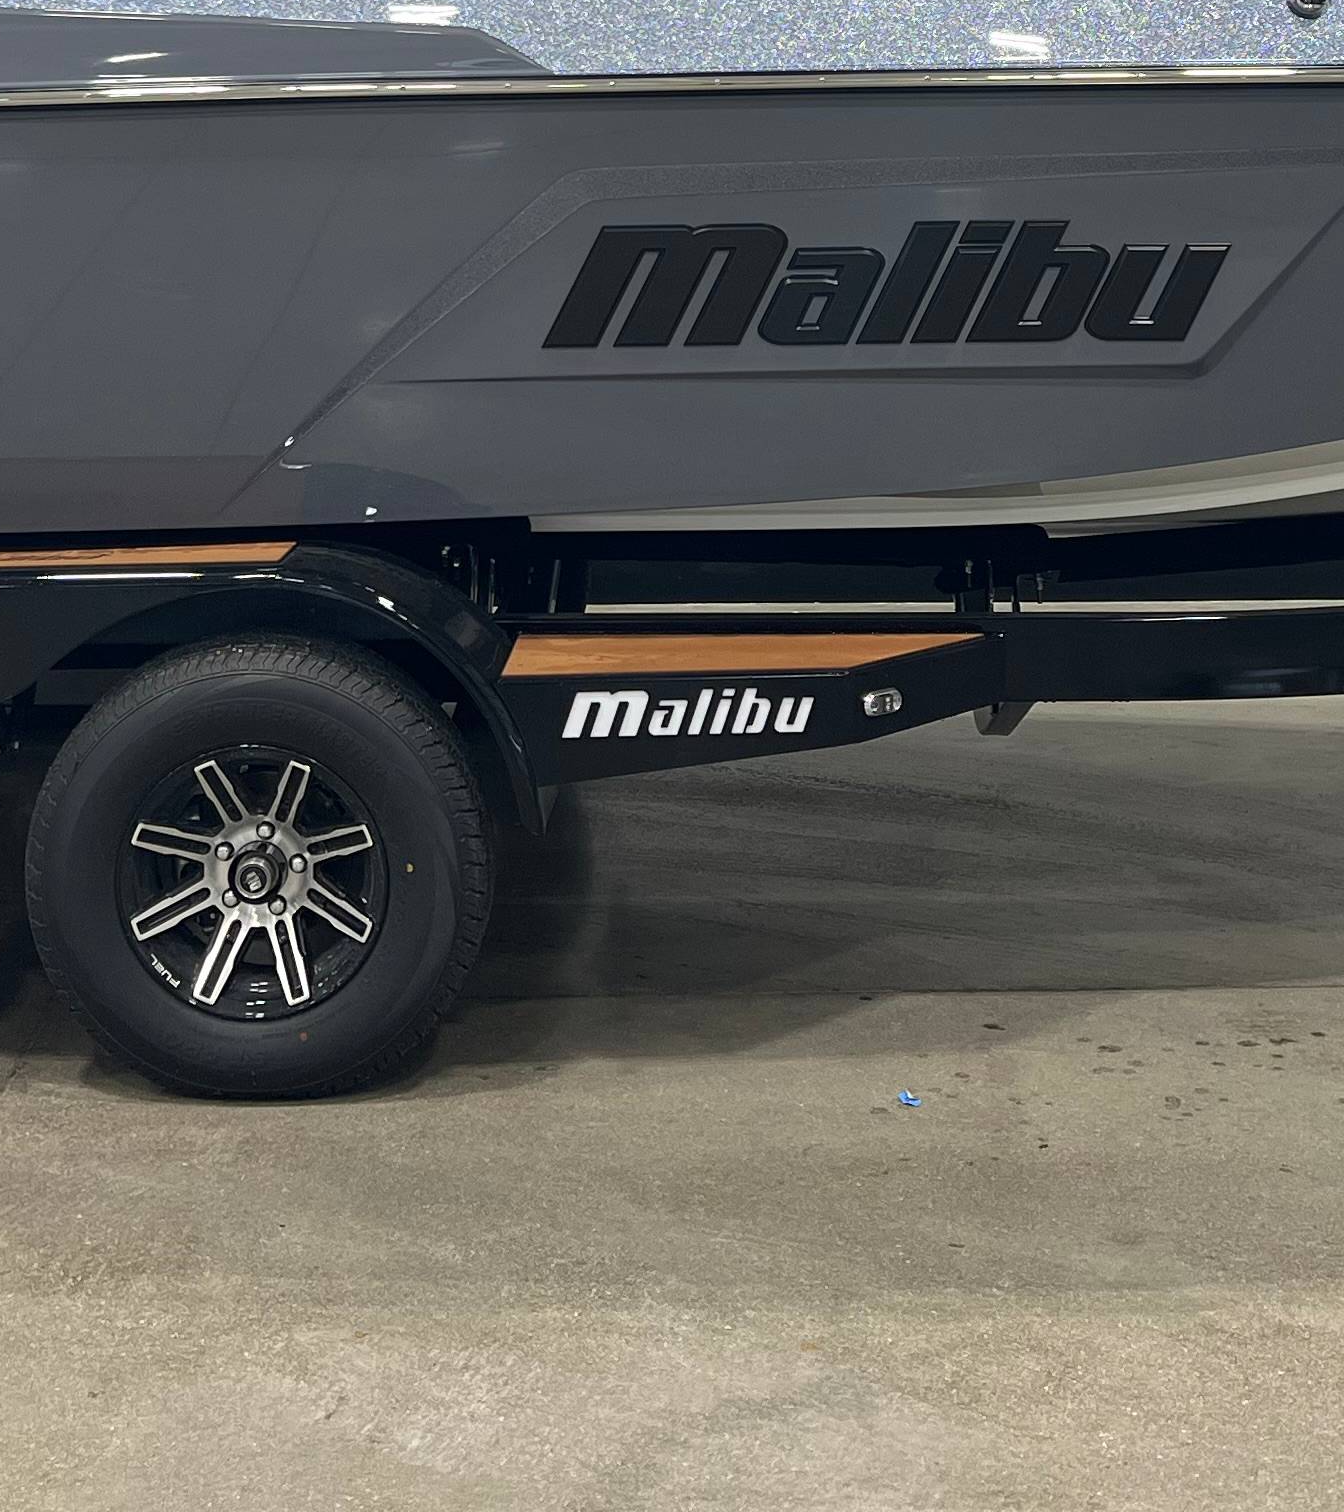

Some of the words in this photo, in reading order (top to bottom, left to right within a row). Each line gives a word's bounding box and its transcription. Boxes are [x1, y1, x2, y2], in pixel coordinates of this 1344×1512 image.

[541, 219, 1233, 349] Malibu
[561, 687, 816, 740] Malibu
[150, 952, 181, 989] FUEL
